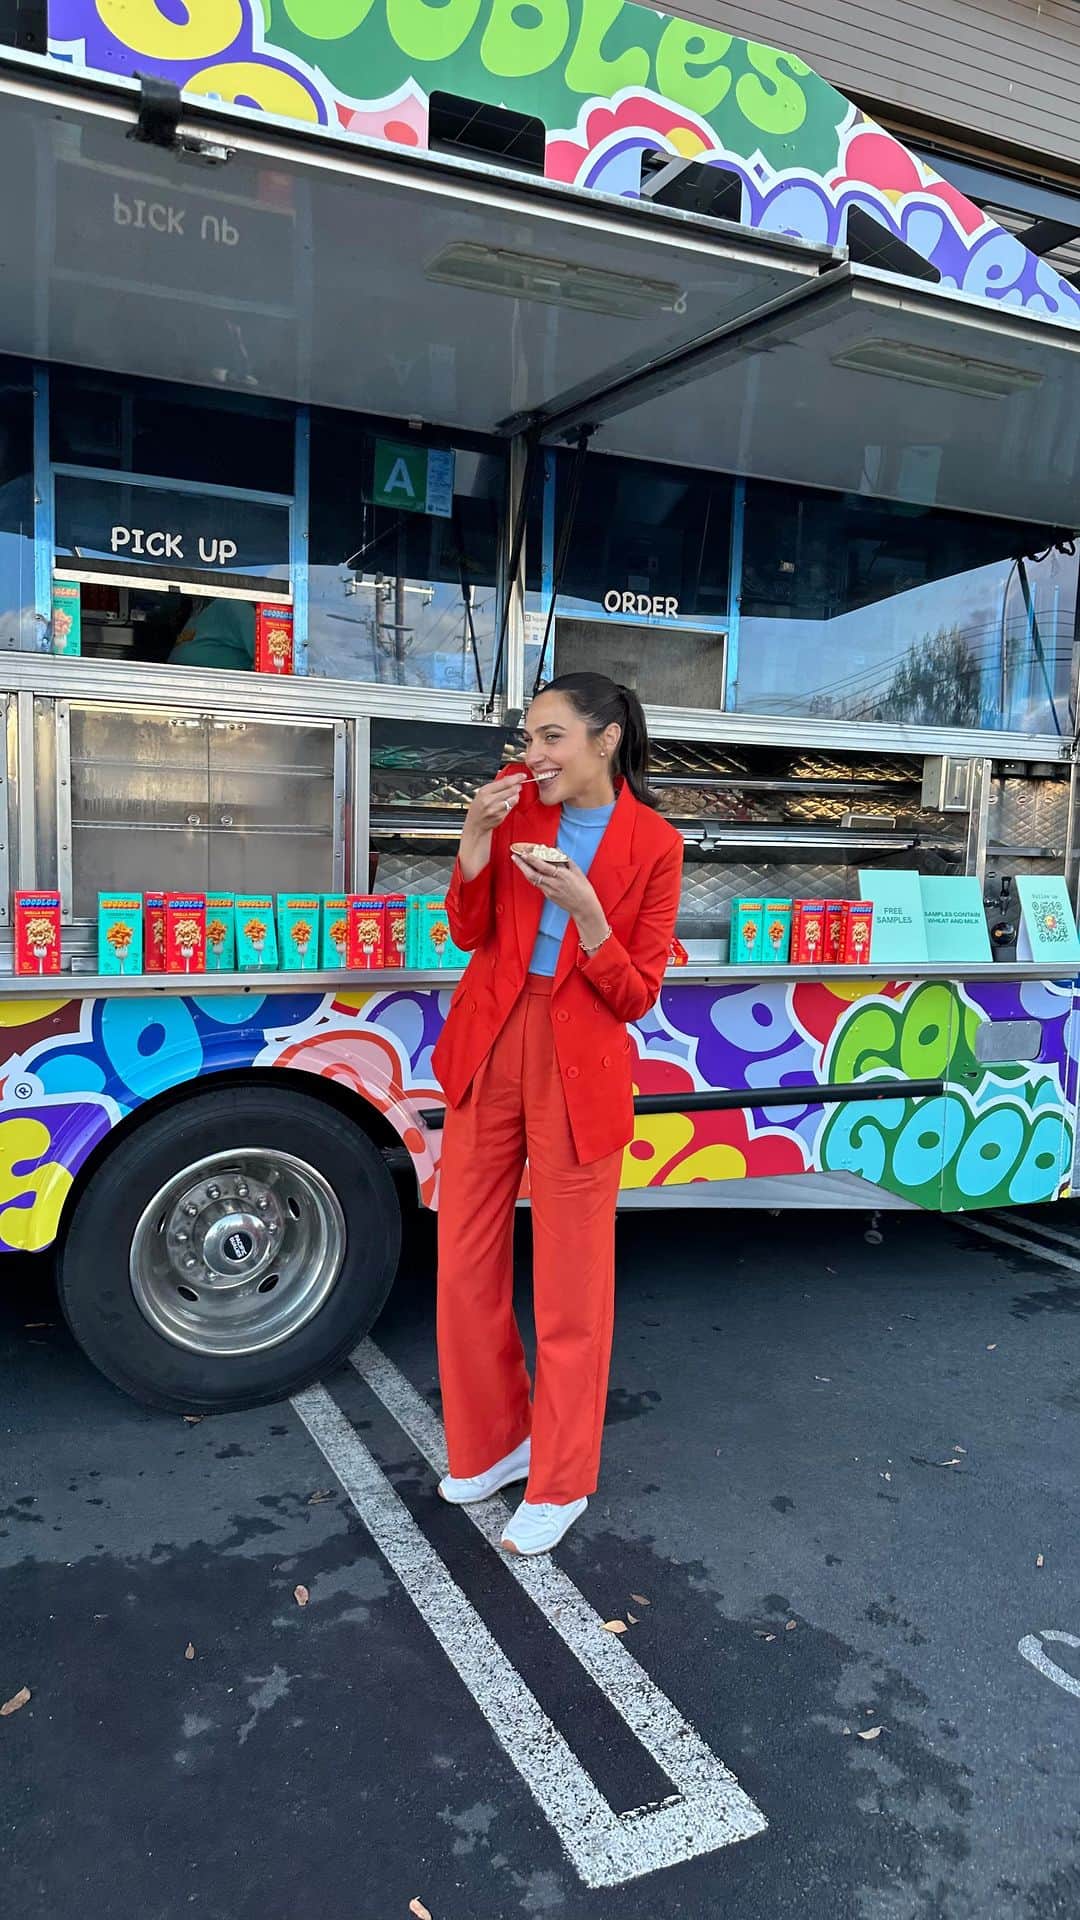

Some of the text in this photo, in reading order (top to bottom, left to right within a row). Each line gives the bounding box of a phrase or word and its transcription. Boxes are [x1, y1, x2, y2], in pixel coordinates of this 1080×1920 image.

[384, 457, 415, 497] A
[111, 526, 237, 565] PICK UP
[604, 590, 679, 619] ORDER
[876, 916, 912, 924] SAMPLES
[883, 907, 903, 915] FREE
[826, 1096, 1071, 1204] GOOD
